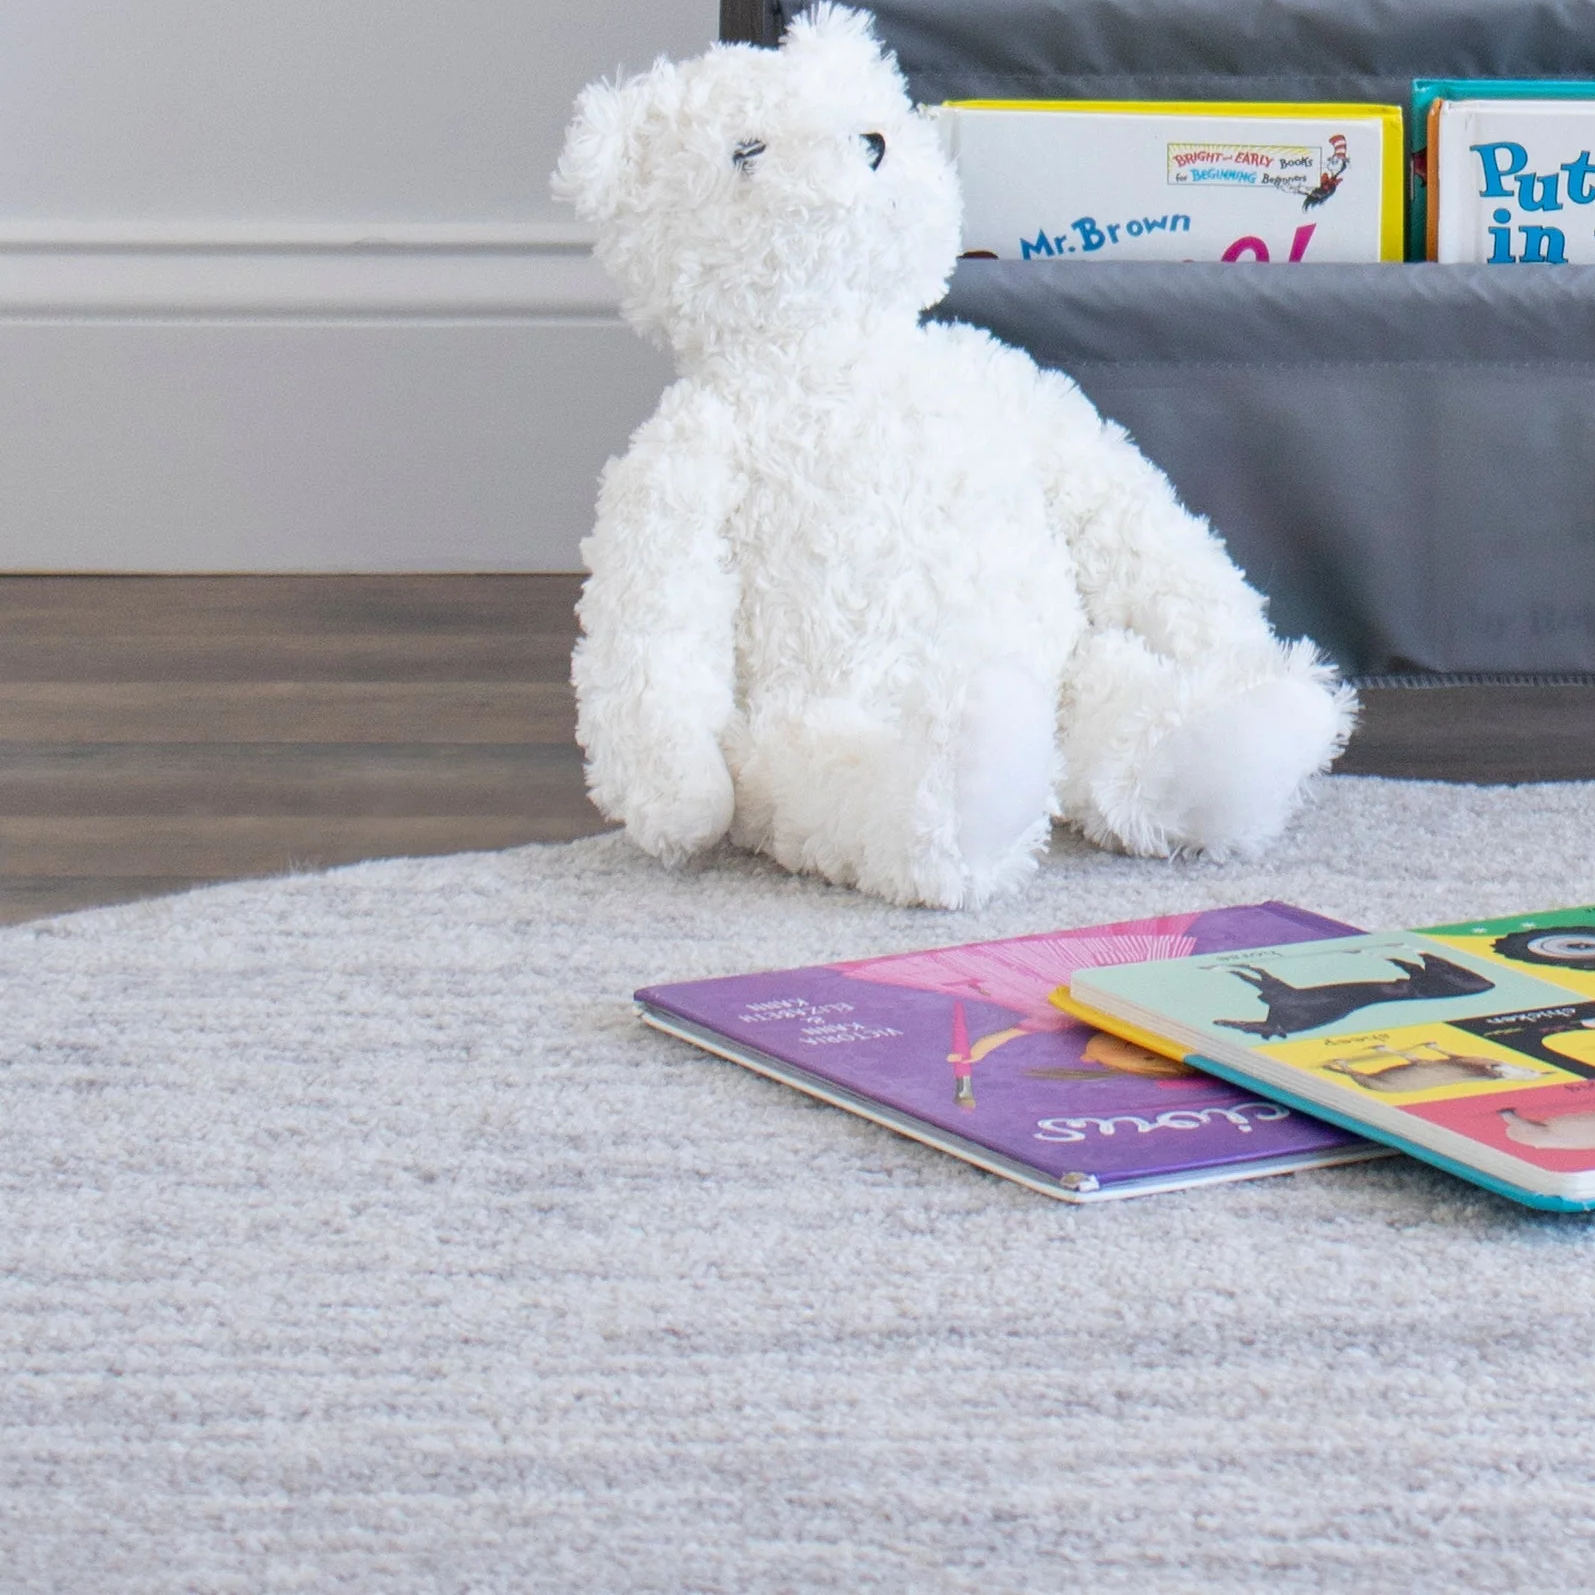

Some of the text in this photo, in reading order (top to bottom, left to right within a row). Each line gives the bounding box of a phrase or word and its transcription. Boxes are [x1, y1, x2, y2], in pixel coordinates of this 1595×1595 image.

[1173, 151, 1223, 168] BRIGHT
[1234, 151, 1275, 168] EARLY
[1176, 173, 1187, 183] for
[1190, 168, 1257, 184] BEGINNING
[1019, 213, 1191, 262] Mr. Brown
[1487, 207, 1568, 265] in
[1486, 1007, 1577, 1025] chicken
